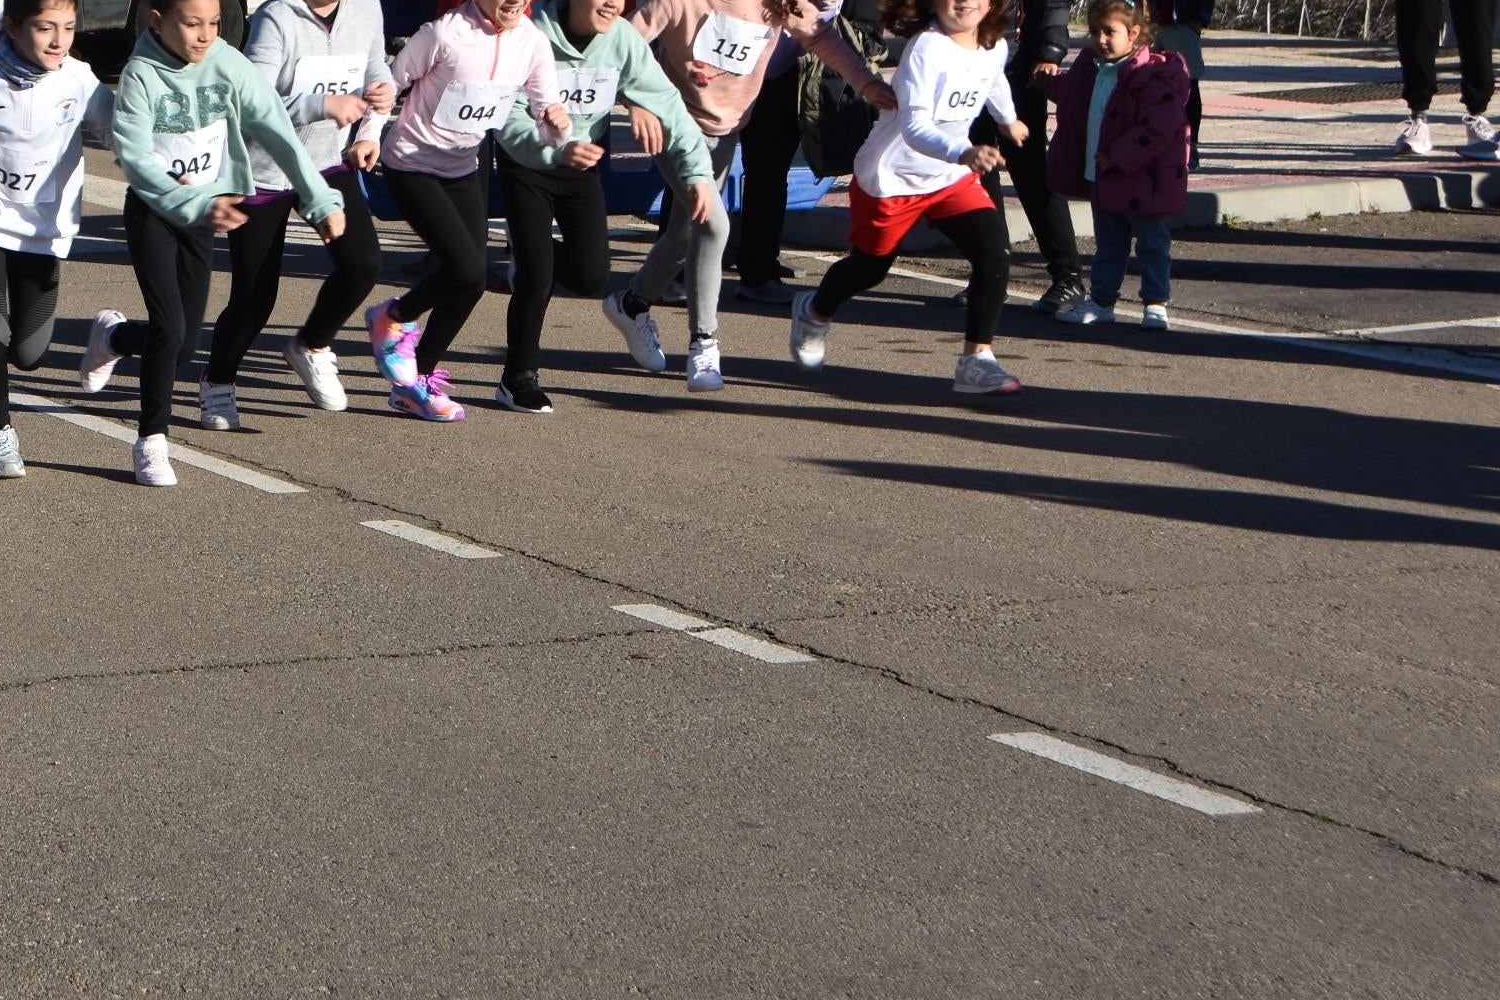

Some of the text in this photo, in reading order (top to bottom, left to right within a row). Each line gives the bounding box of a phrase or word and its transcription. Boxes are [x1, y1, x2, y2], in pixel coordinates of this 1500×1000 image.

[712, 38, 751, 62] 115
[948, 91, 979, 108] 045
[458, 104, 496, 122] 044
[171, 152, 212, 177] 042
